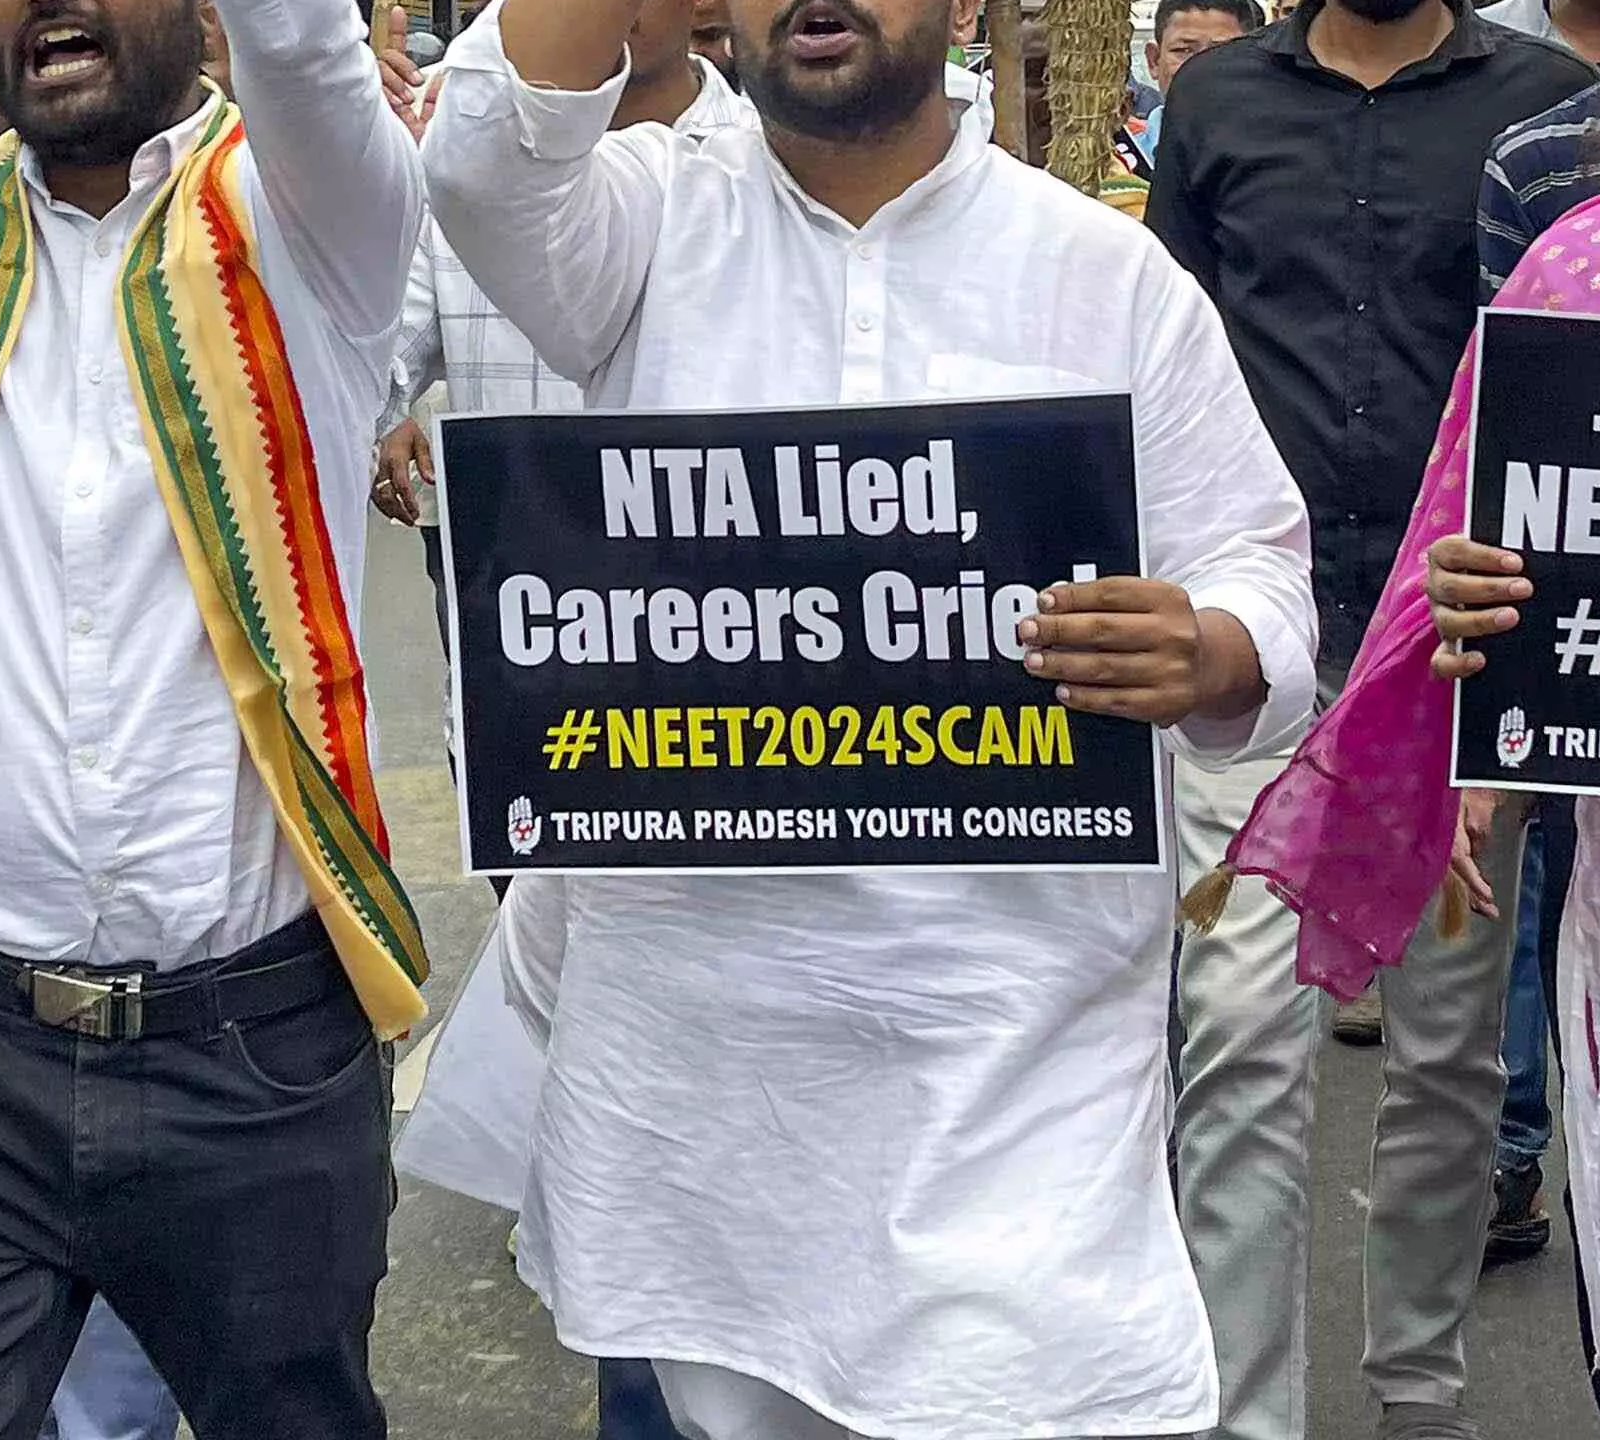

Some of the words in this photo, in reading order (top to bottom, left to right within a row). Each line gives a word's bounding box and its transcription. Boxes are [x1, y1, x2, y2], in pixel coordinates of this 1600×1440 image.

[601, 448, 760, 537] NTA
[775, 440, 977, 543] Lied,
[499, 575, 843, 665] Careers
[863, 563, 1096, 661] Crie
[543, 706, 1073, 769] #NEET2024SCAM
[551, 811, 686, 841] TRIPURA
[695, 809, 837, 840] PRADESH
[846, 808, 952, 838] YOUTH
[963, 806, 1133, 838] CONGRESS
